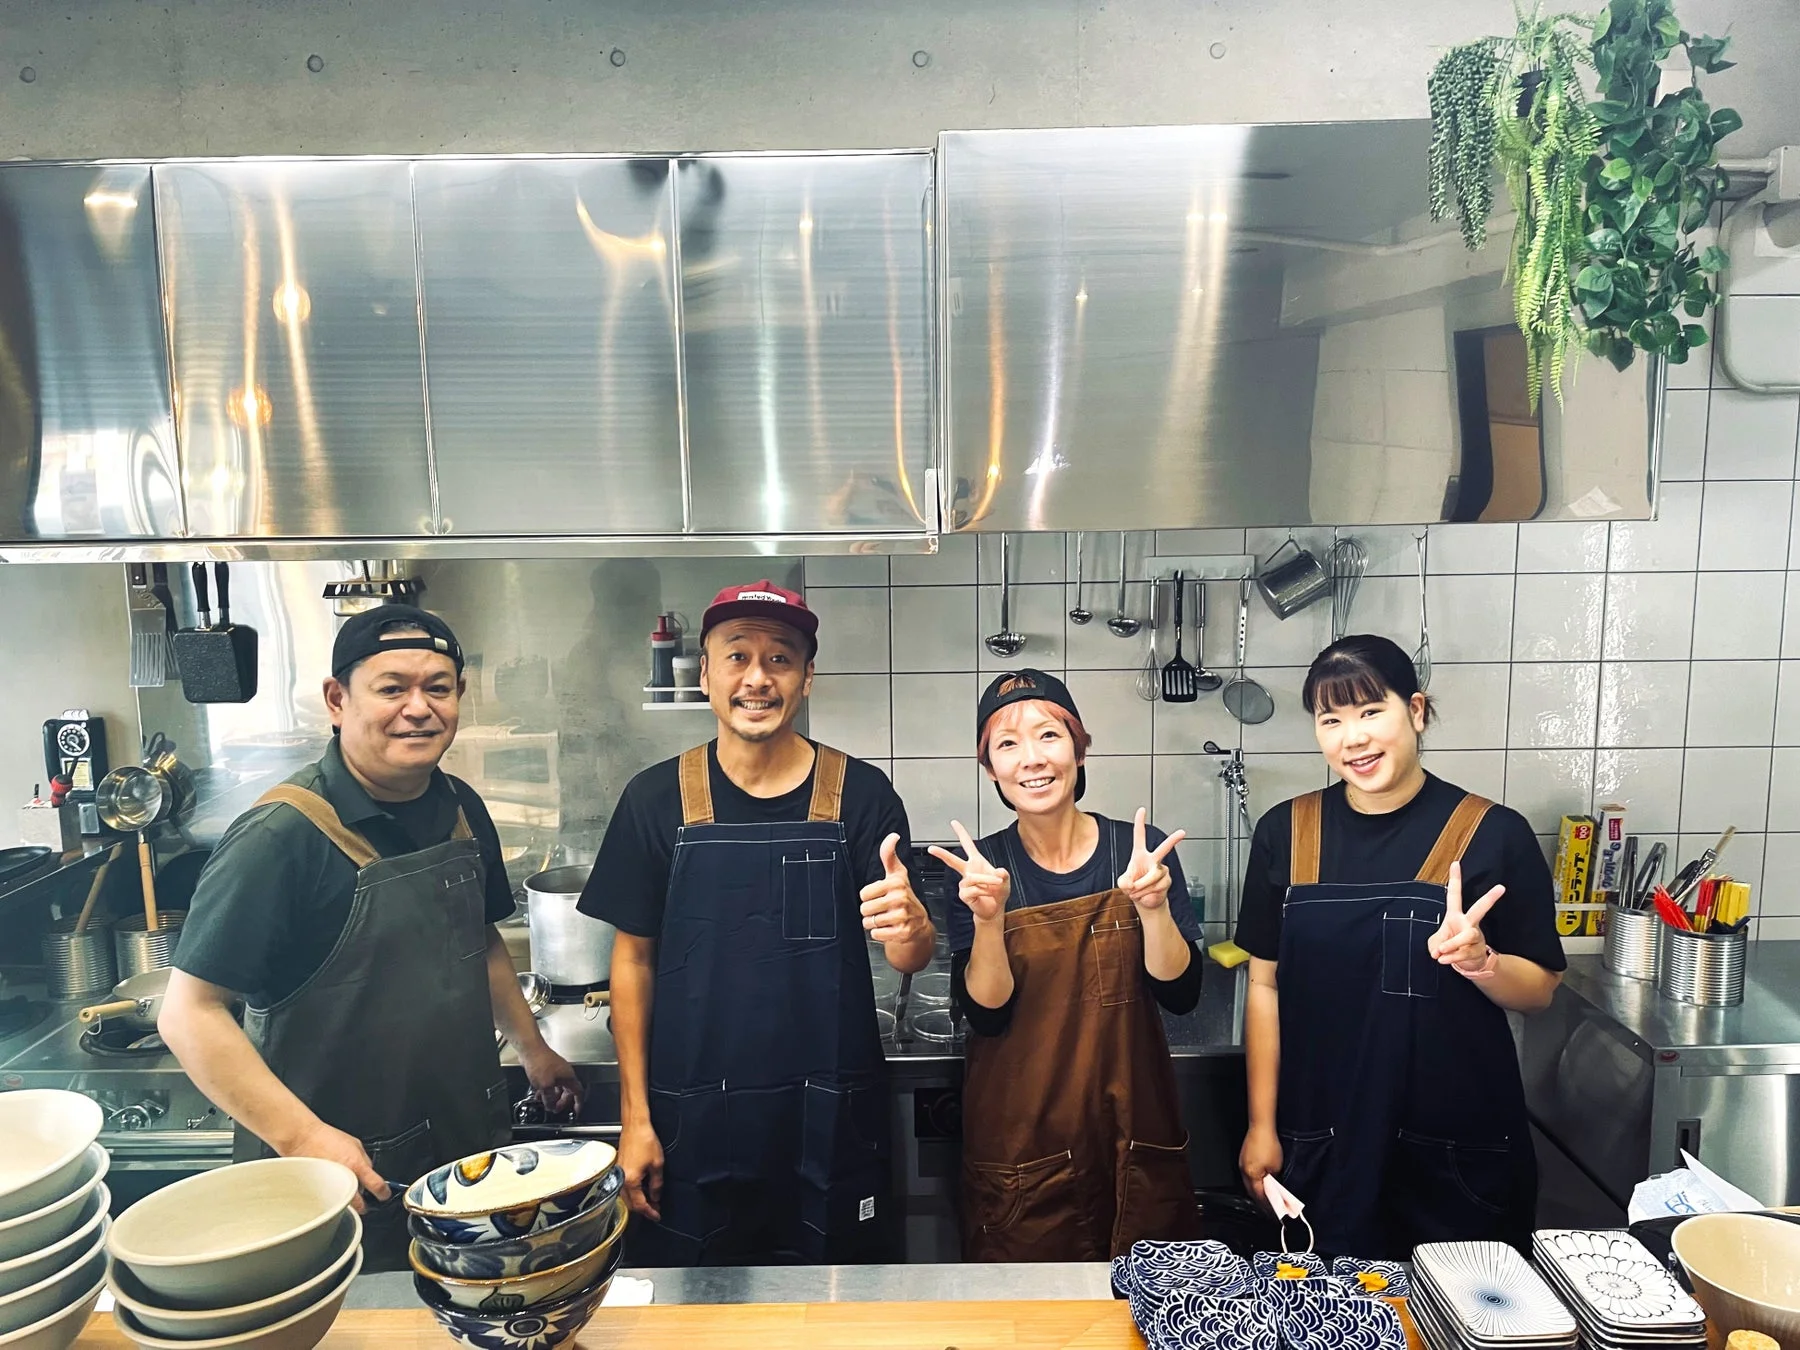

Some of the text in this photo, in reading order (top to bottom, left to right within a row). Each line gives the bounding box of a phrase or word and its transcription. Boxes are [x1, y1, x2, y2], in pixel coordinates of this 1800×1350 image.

[1580, 825, 1590, 839] 100
[1566, 852, 1585, 925] リンラップ
